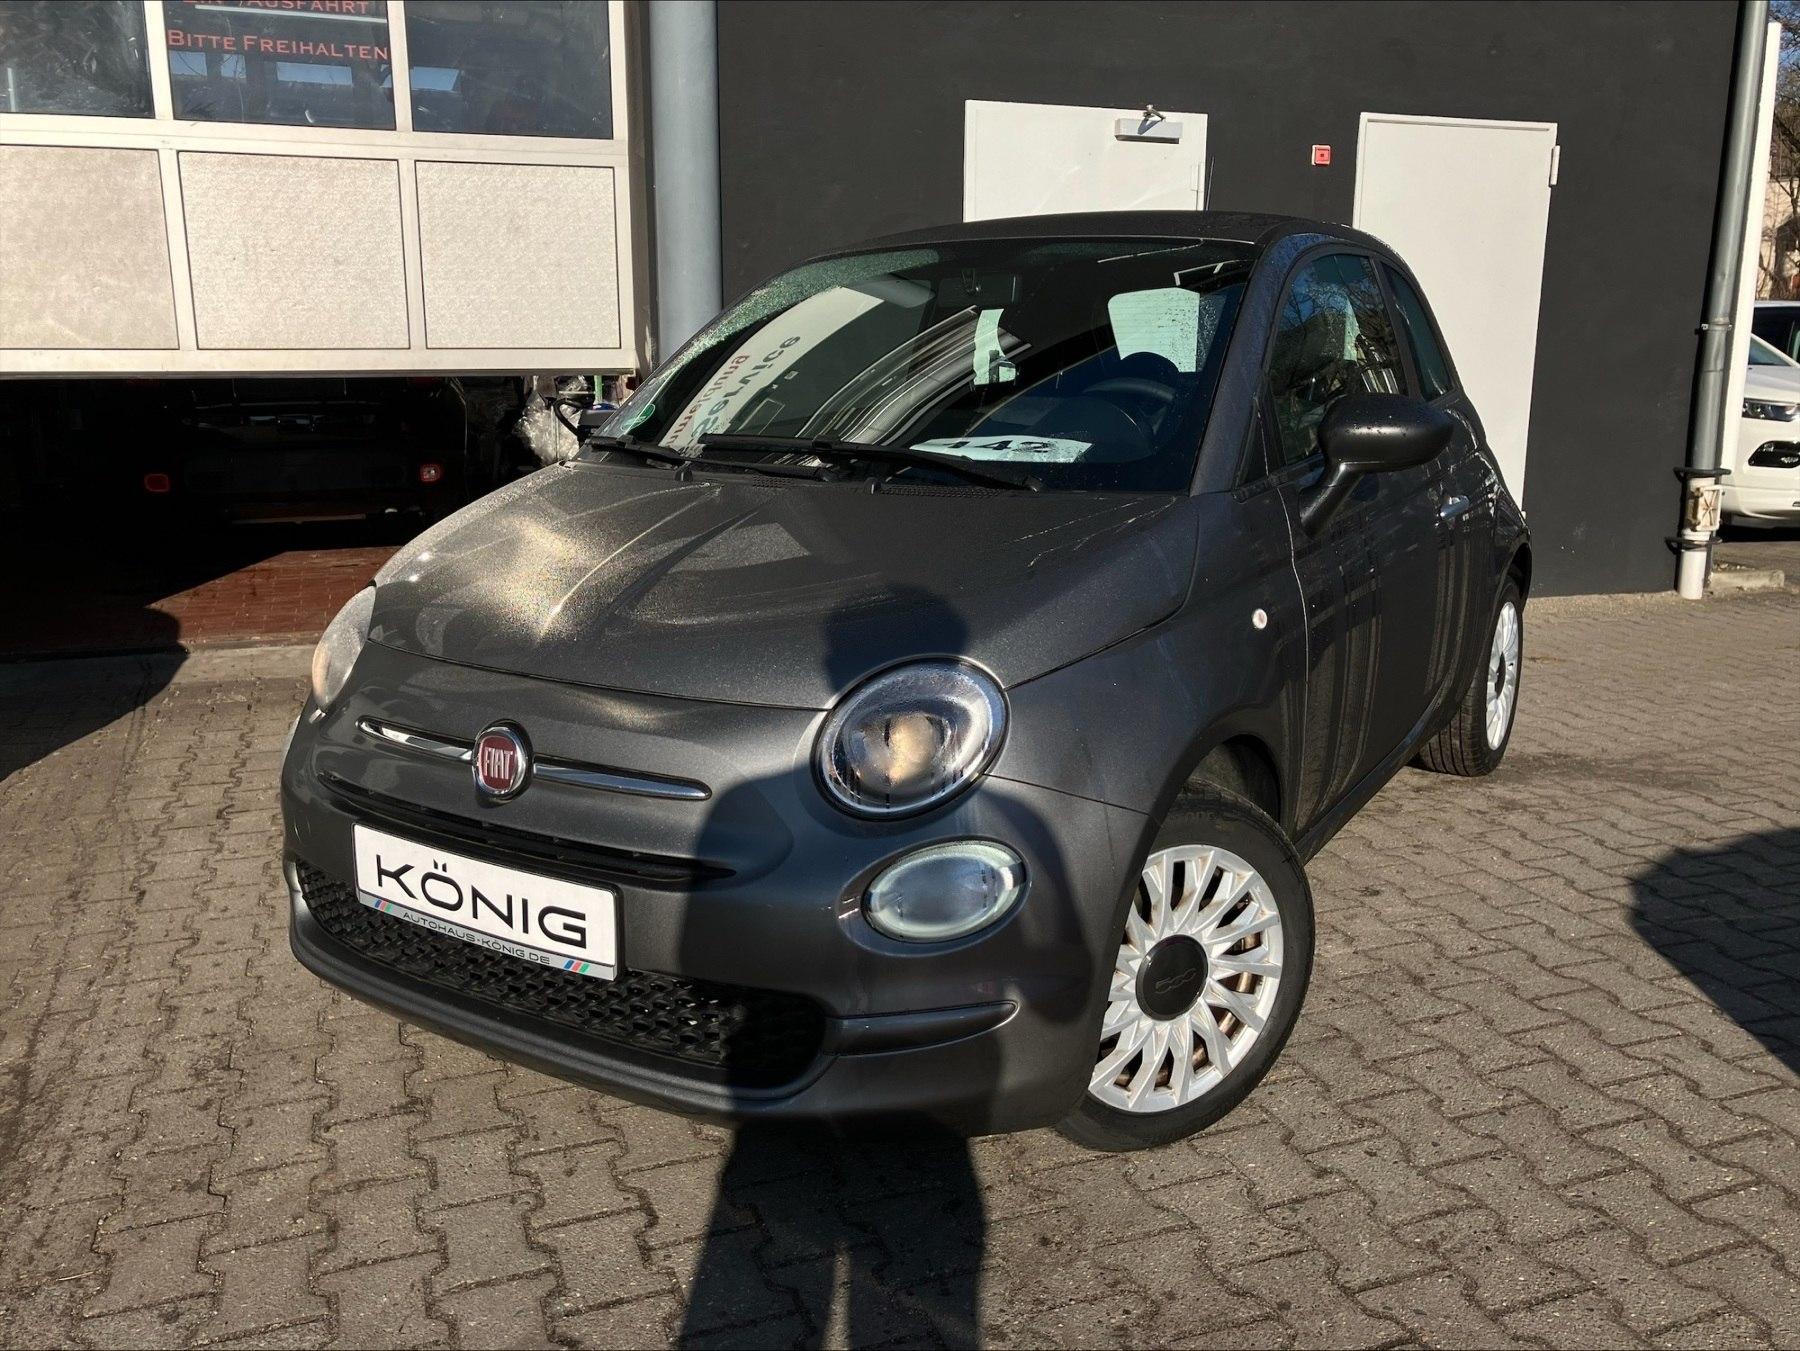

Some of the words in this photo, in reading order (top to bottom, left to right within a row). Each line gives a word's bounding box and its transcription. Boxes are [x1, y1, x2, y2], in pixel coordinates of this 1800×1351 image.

[167, 30, 237, 50] BITTE
[243, 35, 388, 60] FREIHALTEN
[482, 746, 514, 780] FIAT
[375, 853, 588, 950] KÖNIG
